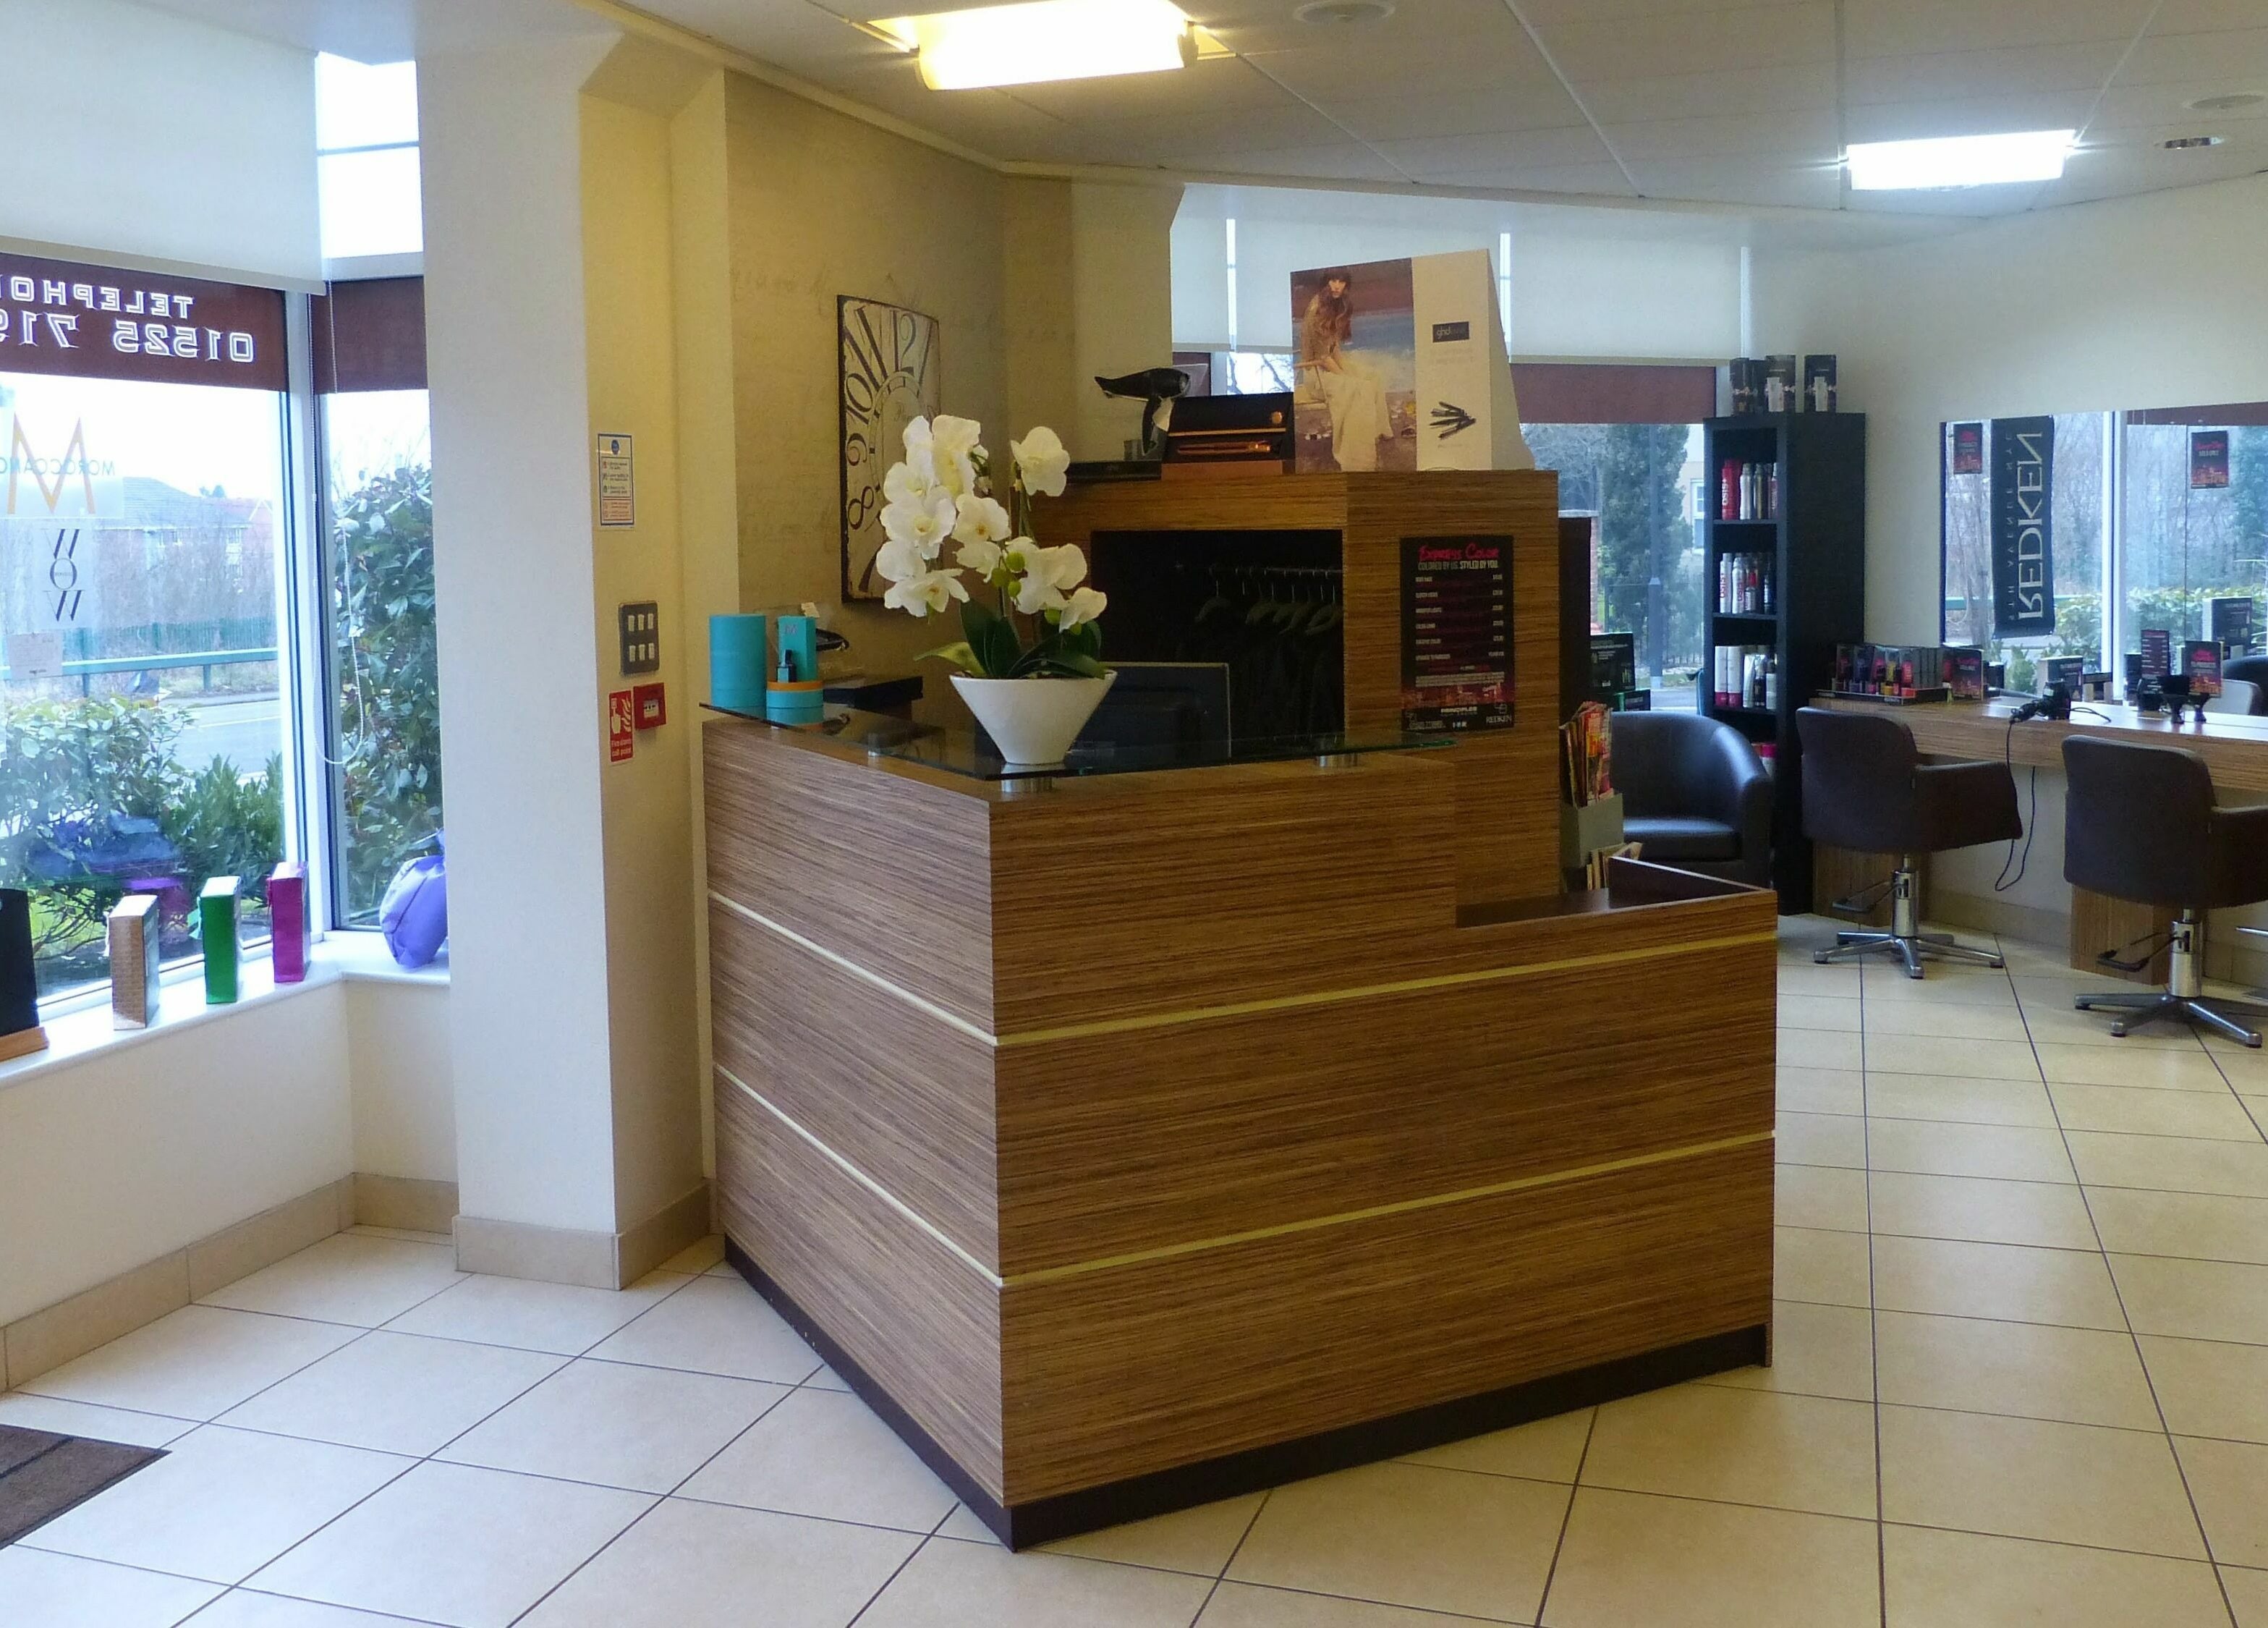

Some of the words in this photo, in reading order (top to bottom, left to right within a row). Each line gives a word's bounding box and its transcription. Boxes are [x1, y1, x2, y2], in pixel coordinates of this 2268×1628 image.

[889, 310, 914, 377] 12
[1436, 325, 1451, 339] ghd
[845, 373, 873, 425] 10
[846, 432, 868, 466] 9
[847, 486, 875, 530] 8
